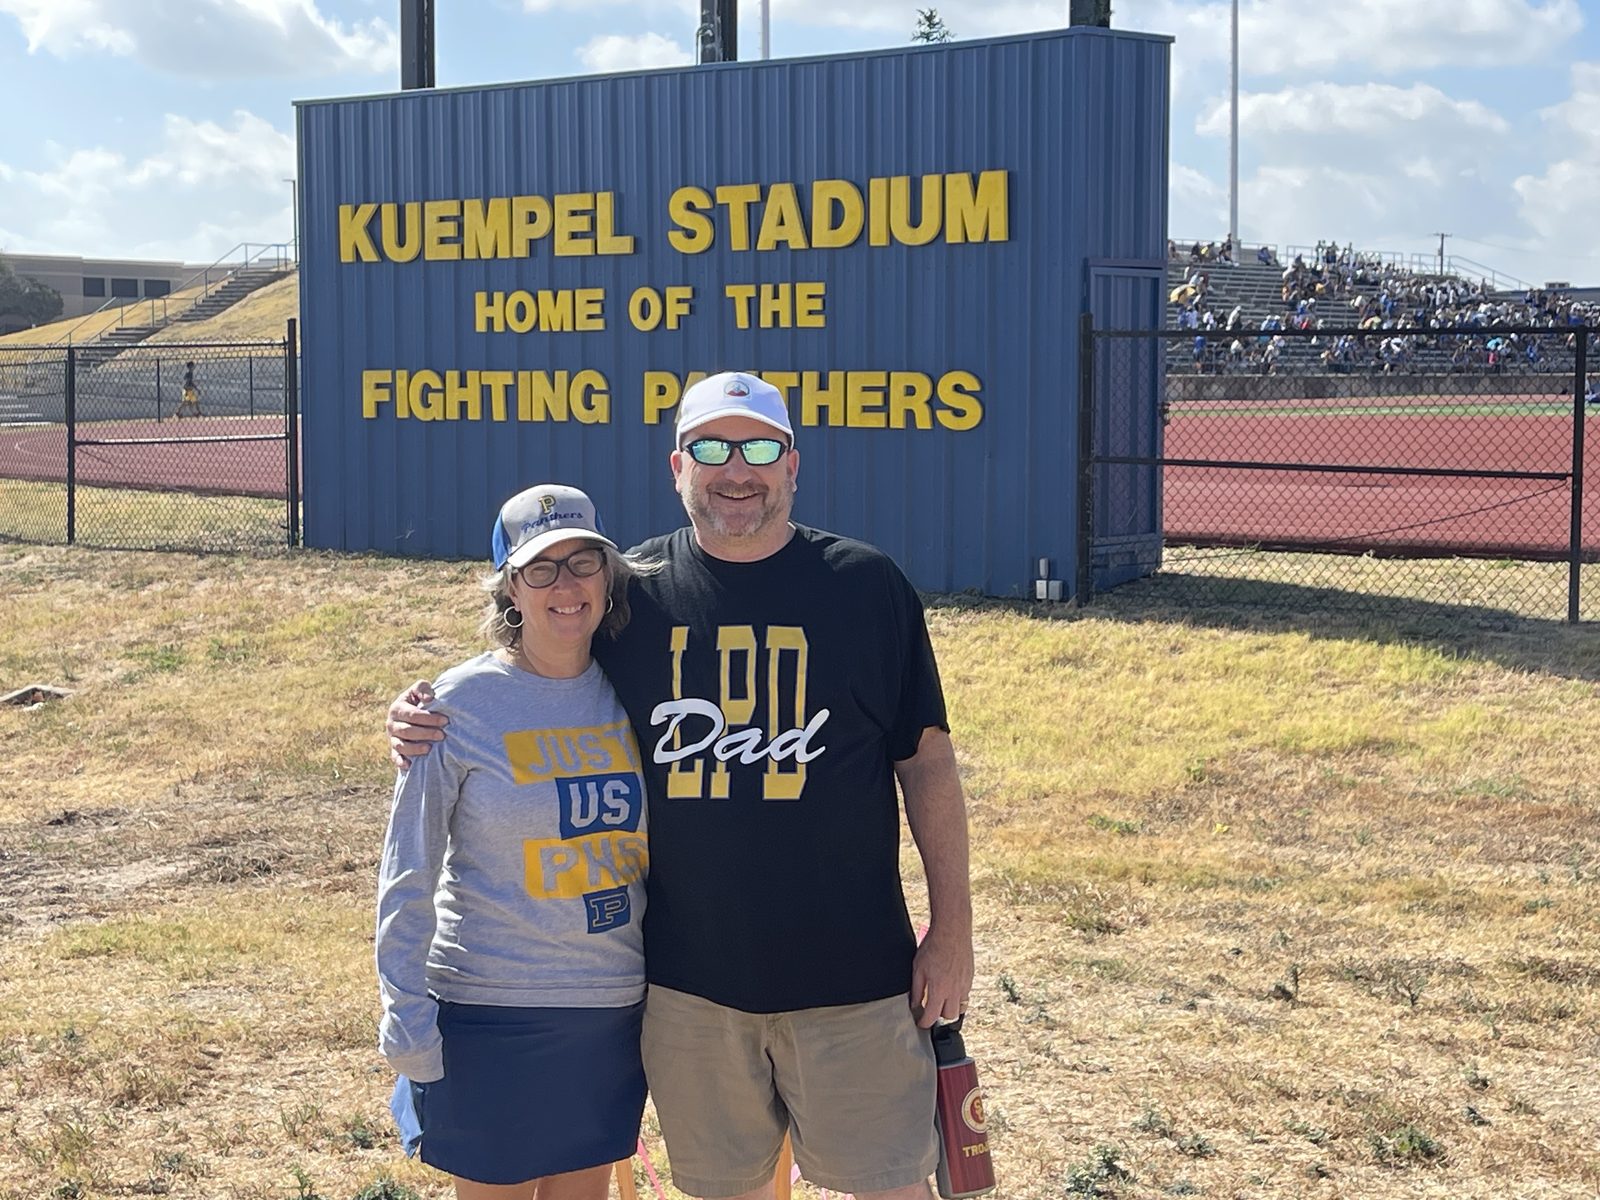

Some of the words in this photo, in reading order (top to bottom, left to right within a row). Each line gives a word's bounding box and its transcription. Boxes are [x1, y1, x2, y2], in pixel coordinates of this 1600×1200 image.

[338, 191, 634, 263] KUEMPEL
[668, 169, 1010, 255] STADIUM
[474, 287, 606, 333] HOME
[628, 285, 694, 332] OF
[725, 281, 827, 330] THE
[361, 369, 611, 425] FIGHTING
[643, 370, 984, 431] PTHERS
[521, 512, 583, 533] Panthers
[538, 495, 556, 514] P
[650, 698, 831, 765] Dad
[667, 624, 809, 800] LPD
[528, 727, 637, 775] JUST
[568, 779, 632, 829] US
[589, 892, 630, 928] P
